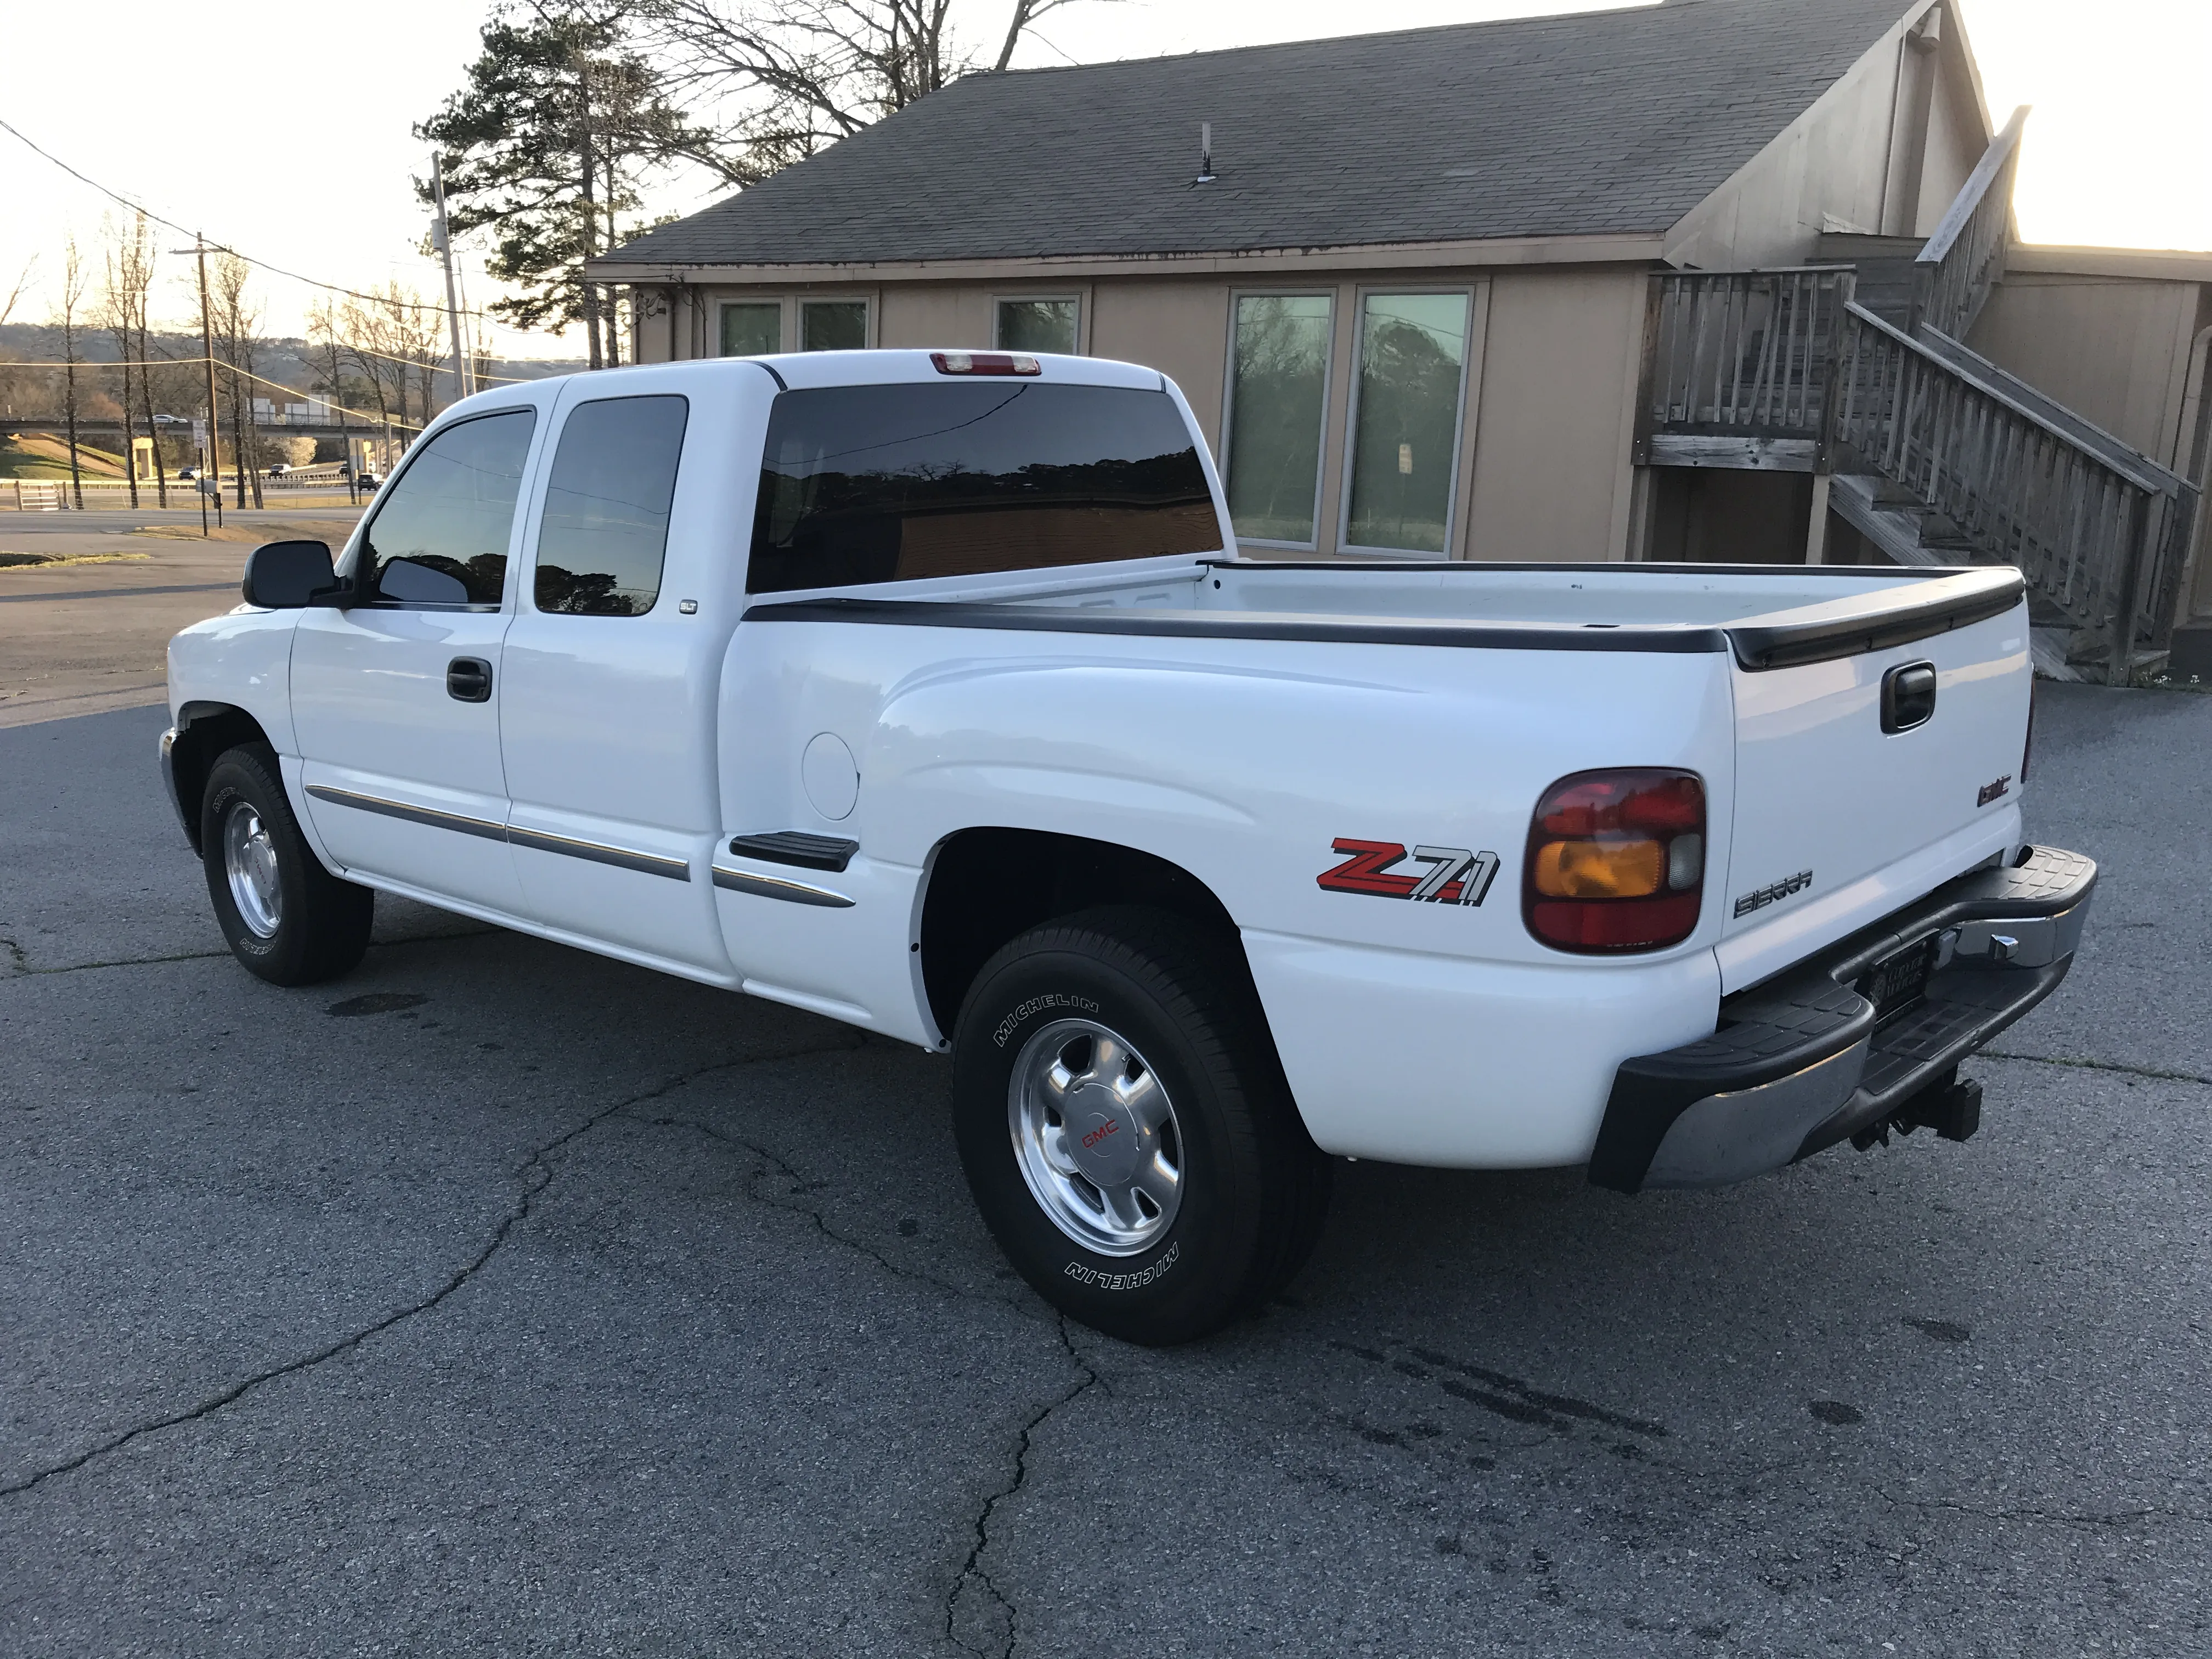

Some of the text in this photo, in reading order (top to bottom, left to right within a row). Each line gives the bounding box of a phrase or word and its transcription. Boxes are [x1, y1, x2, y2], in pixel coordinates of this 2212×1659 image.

[680, 602, 696, 611] SLT
[1317, 837, 1500, 907] Z71
[1733, 868, 1813, 919] SIERRA
[993, 994, 1099, 1048] MICHELIN
[1082, 1119, 1119, 1148] GMC
[1064, 1241, 1179, 1290] MICHELIN
